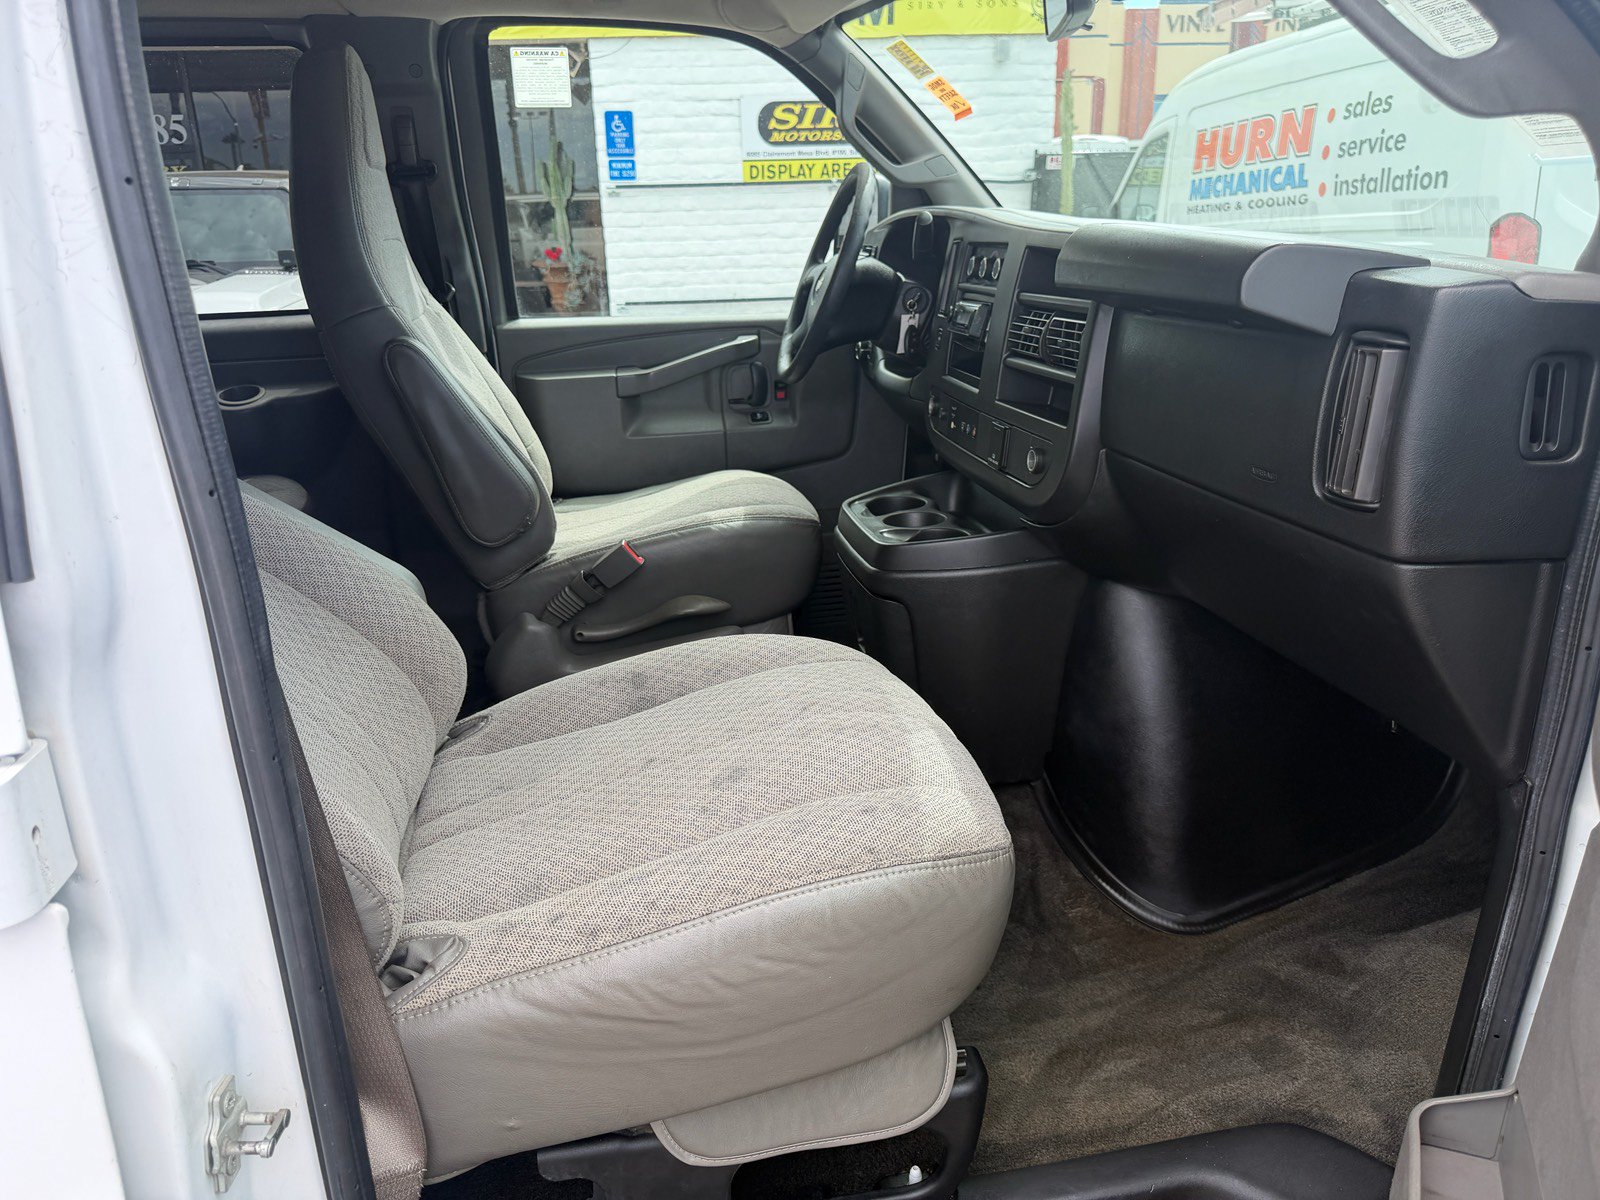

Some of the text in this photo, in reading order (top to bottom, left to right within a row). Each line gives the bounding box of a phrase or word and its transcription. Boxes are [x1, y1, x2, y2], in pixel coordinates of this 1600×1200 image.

[907, 0, 945, 10] SIRY
[976, 0, 1018, 9] SONS
[1167, 14, 1225, 32] VINL
[1343, 91, 1393, 120] sales
[1193, 103, 1318, 174] HURN
[1337, 129, 1406, 158] service
[750, 163, 852, 179] DISPLAY ARE
[1190, 163, 1308, 200] MECHANICAL
[1333, 166, 1448, 197] installation
[1187, 194, 1309, 215] HEATING & COOLING
